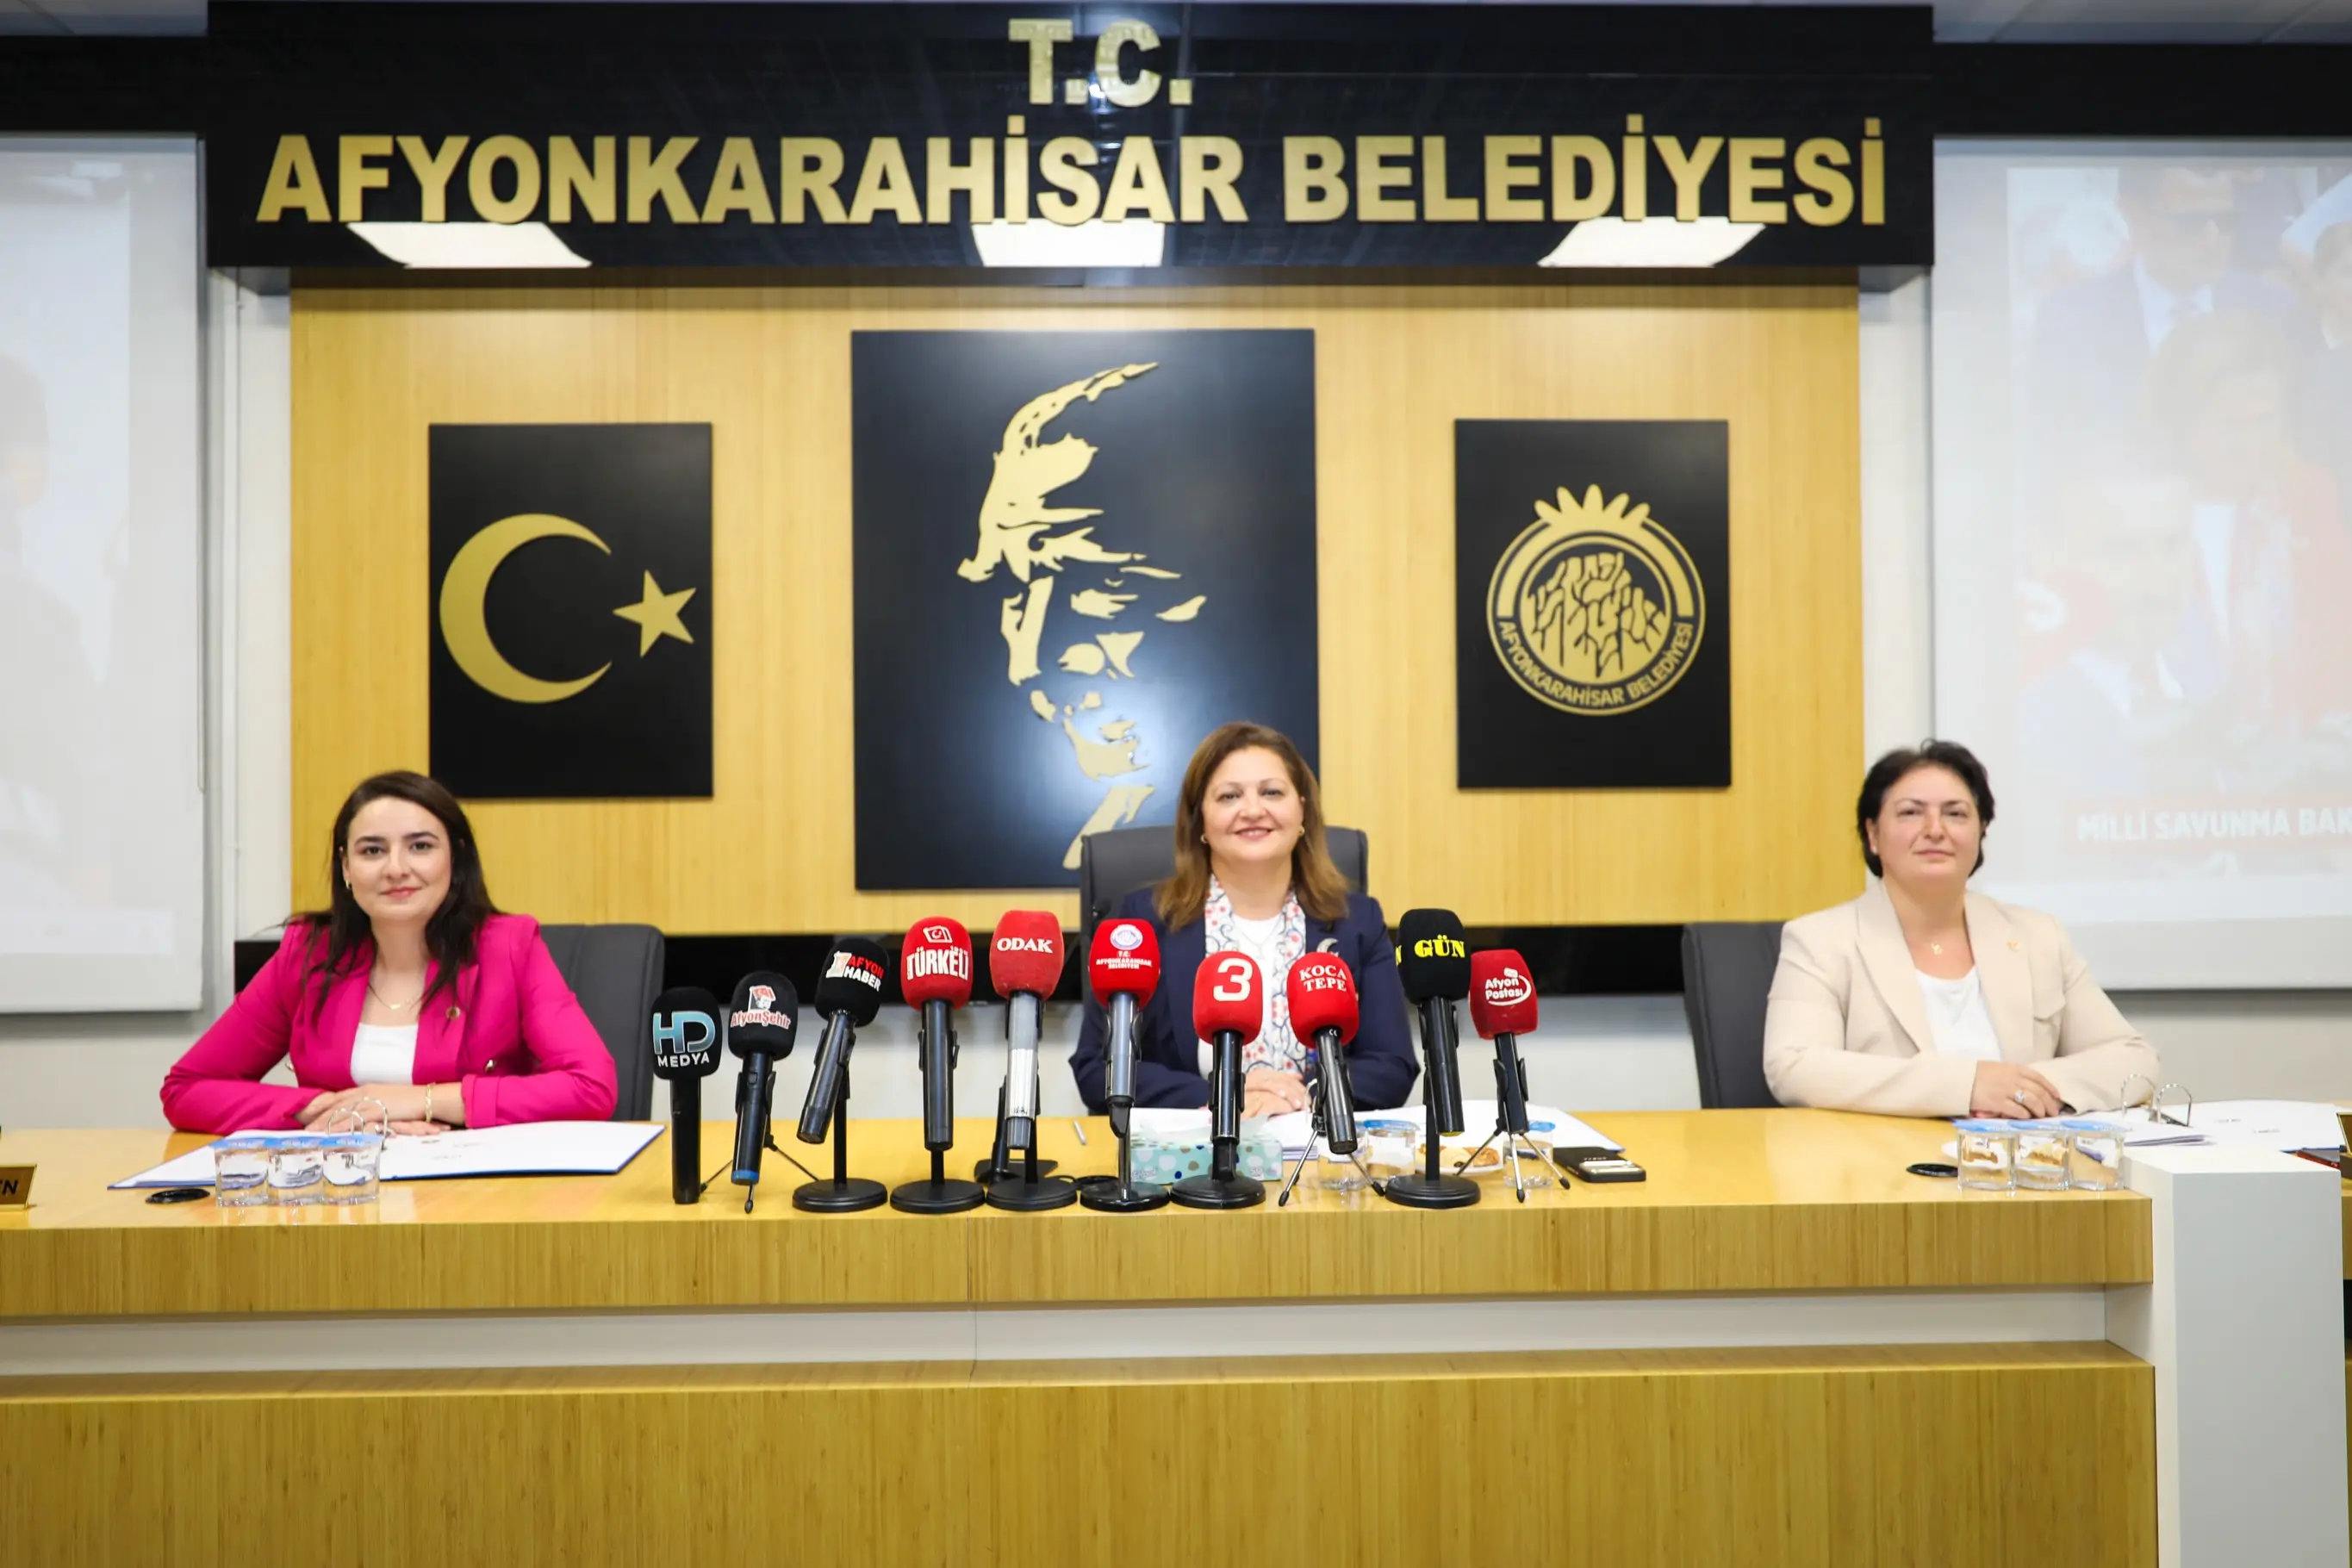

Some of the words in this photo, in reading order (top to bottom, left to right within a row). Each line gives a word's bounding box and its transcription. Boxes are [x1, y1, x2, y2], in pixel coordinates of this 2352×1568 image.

[1008, 17, 1192, 108] T.C.
[256, 115, 1248, 225] AFYONKARAHİSAR
[1283, 113, 1885, 227] BELEDİYESİ
[1498, 620, 1626, 707] AFYONKARAHİSAR
[1628, 621, 1695, 700] BELEDİYESİ
[2154, 807, 2291, 840] SAVUNMA
[997, 937, 1053, 954] ODAK
[1414, 935, 1465, 959] GÜN
[848, 955, 885, 980] AFYON
[906, 946, 968, 980] TÜRKELİ
[1299, 965, 1347, 980] KOCA
[843, 966, 880, 992] HABER
[1213, 958, 1253, 1001] 3
[1304, 977, 1347, 992] TEPE
[1485, 977, 1520, 989] Afyon
[1485, 987, 1523, 1000] Postası
[652, 1011, 716, 1055] HD
[657, 1052, 710, 1067] MEDYA
